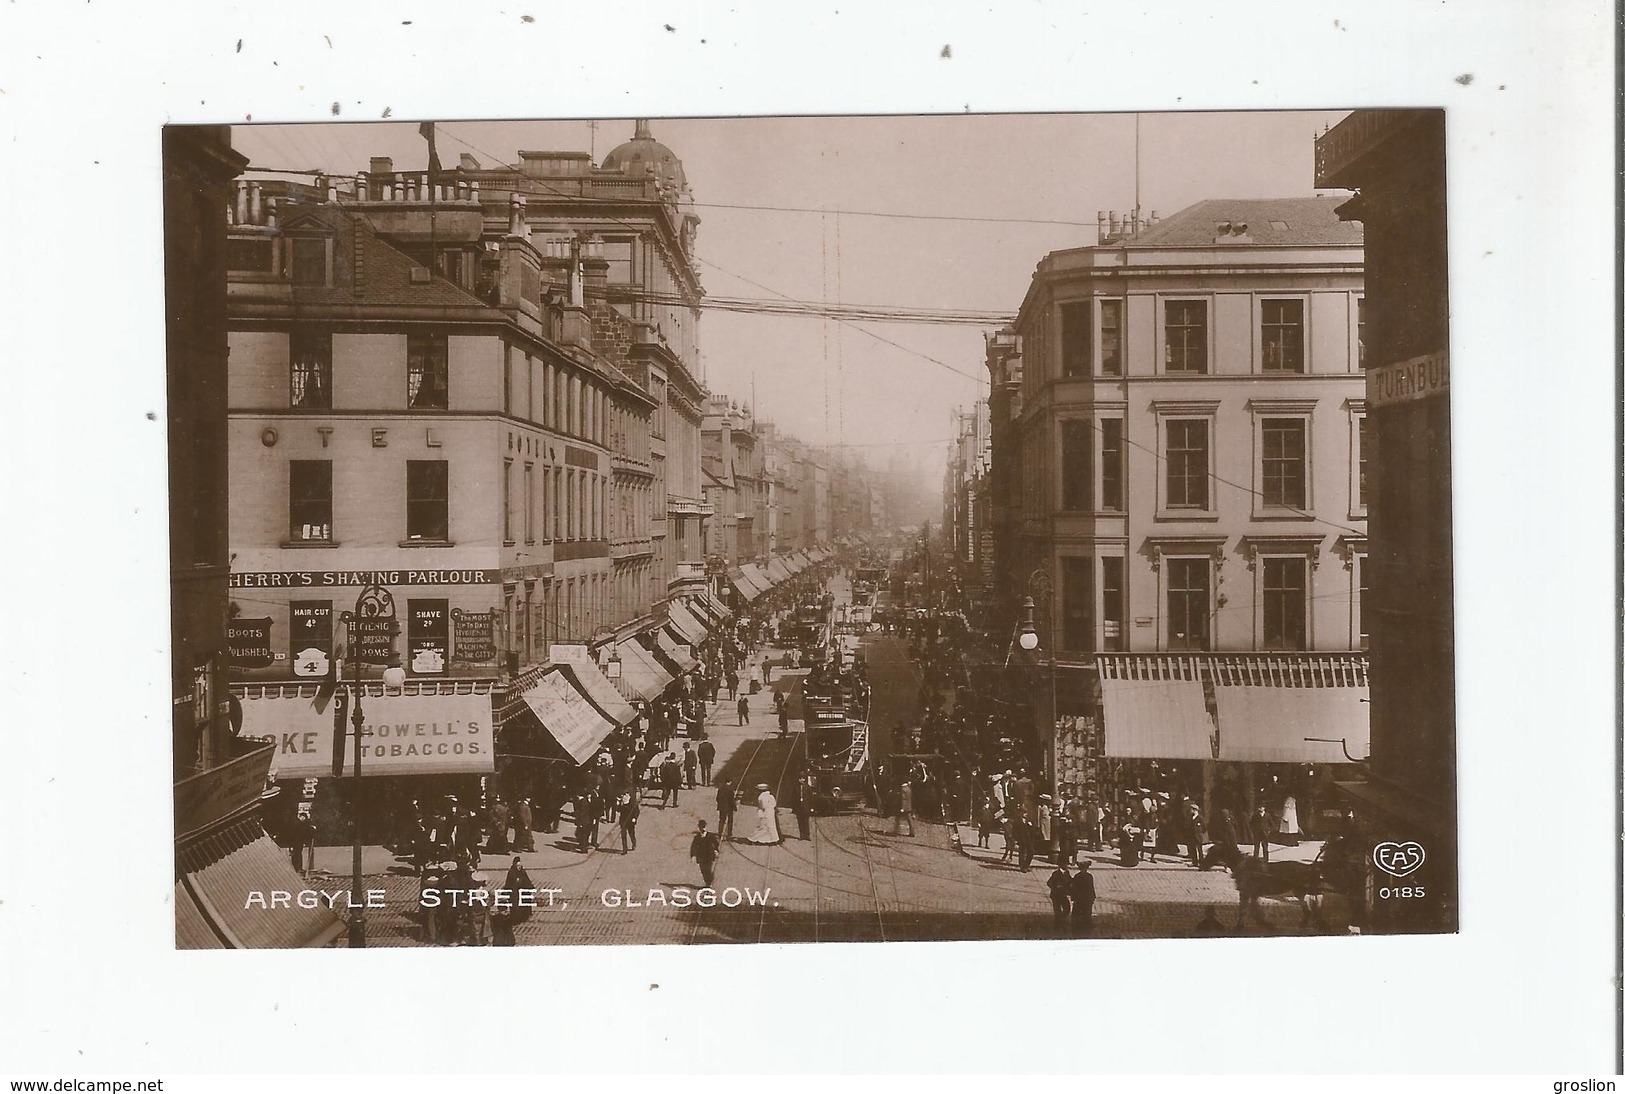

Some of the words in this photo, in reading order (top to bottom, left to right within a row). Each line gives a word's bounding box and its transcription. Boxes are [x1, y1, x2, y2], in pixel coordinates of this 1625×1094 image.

[408, 571, 491, 583] PARLOUR.
[294, 608, 312, 616] HAIR
[314, 608, 330, 616] CUT
[349, 621, 389, 631] HGIENIC
[353, 647, 389, 657] OOMS
[361, 721, 480, 737] HOWELL'S
[361, 742, 487, 758] TOBACCOS.
